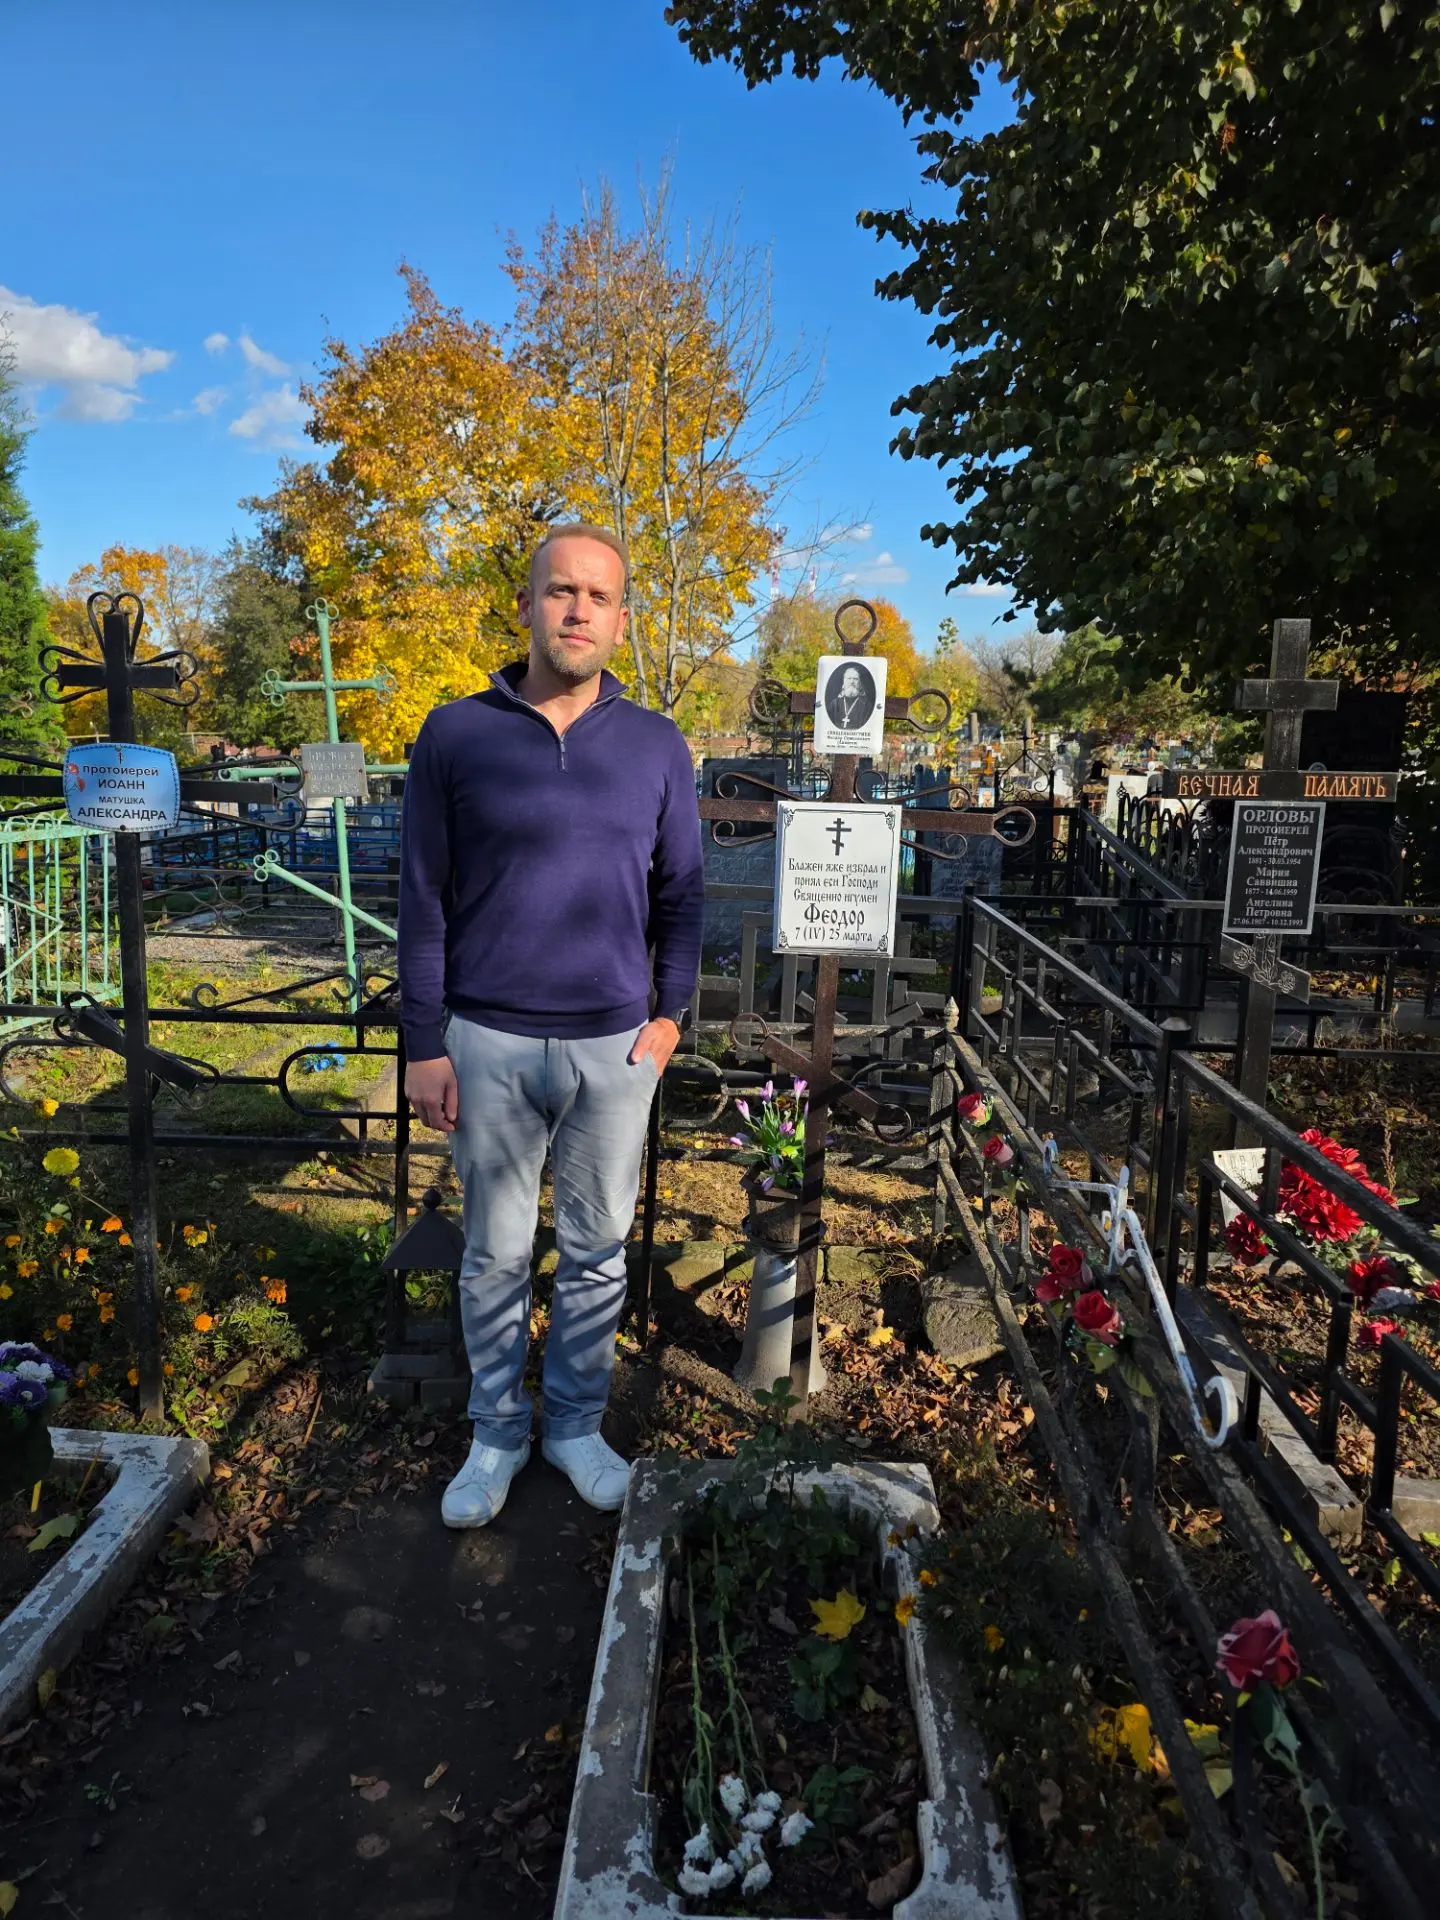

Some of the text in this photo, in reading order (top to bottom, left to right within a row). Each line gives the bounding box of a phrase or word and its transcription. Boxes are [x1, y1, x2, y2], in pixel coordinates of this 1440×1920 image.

[83, 764, 159, 777] протоиерей
[98, 779, 145, 790] ИОАНН
[1178, 775, 1387, 798] ВЕЧНАЯ ПАМЯТЬ
[98, 796, 145, 805] МАТУШКА
[77, 807, 167, 821] АЛЕКСАНДРА
[1243, 809, 1316, 823] ОРЛОВЫ
[1263, 835, 1288, 848] Пётр
[1237, 845, 1313, 857] Александрович
[788, 858, 823, 872] Блажен
[846, 863, 878, 877] избрал
[841, 874, 879, 890] Господи
[793, 888, 878, 906] Священно игумен
[804, 903, 865, 931] Феодор
[1245, 907, 1292, 919] Петровна
[795, 926, 873, 944] 7 (IV) 25 марта
